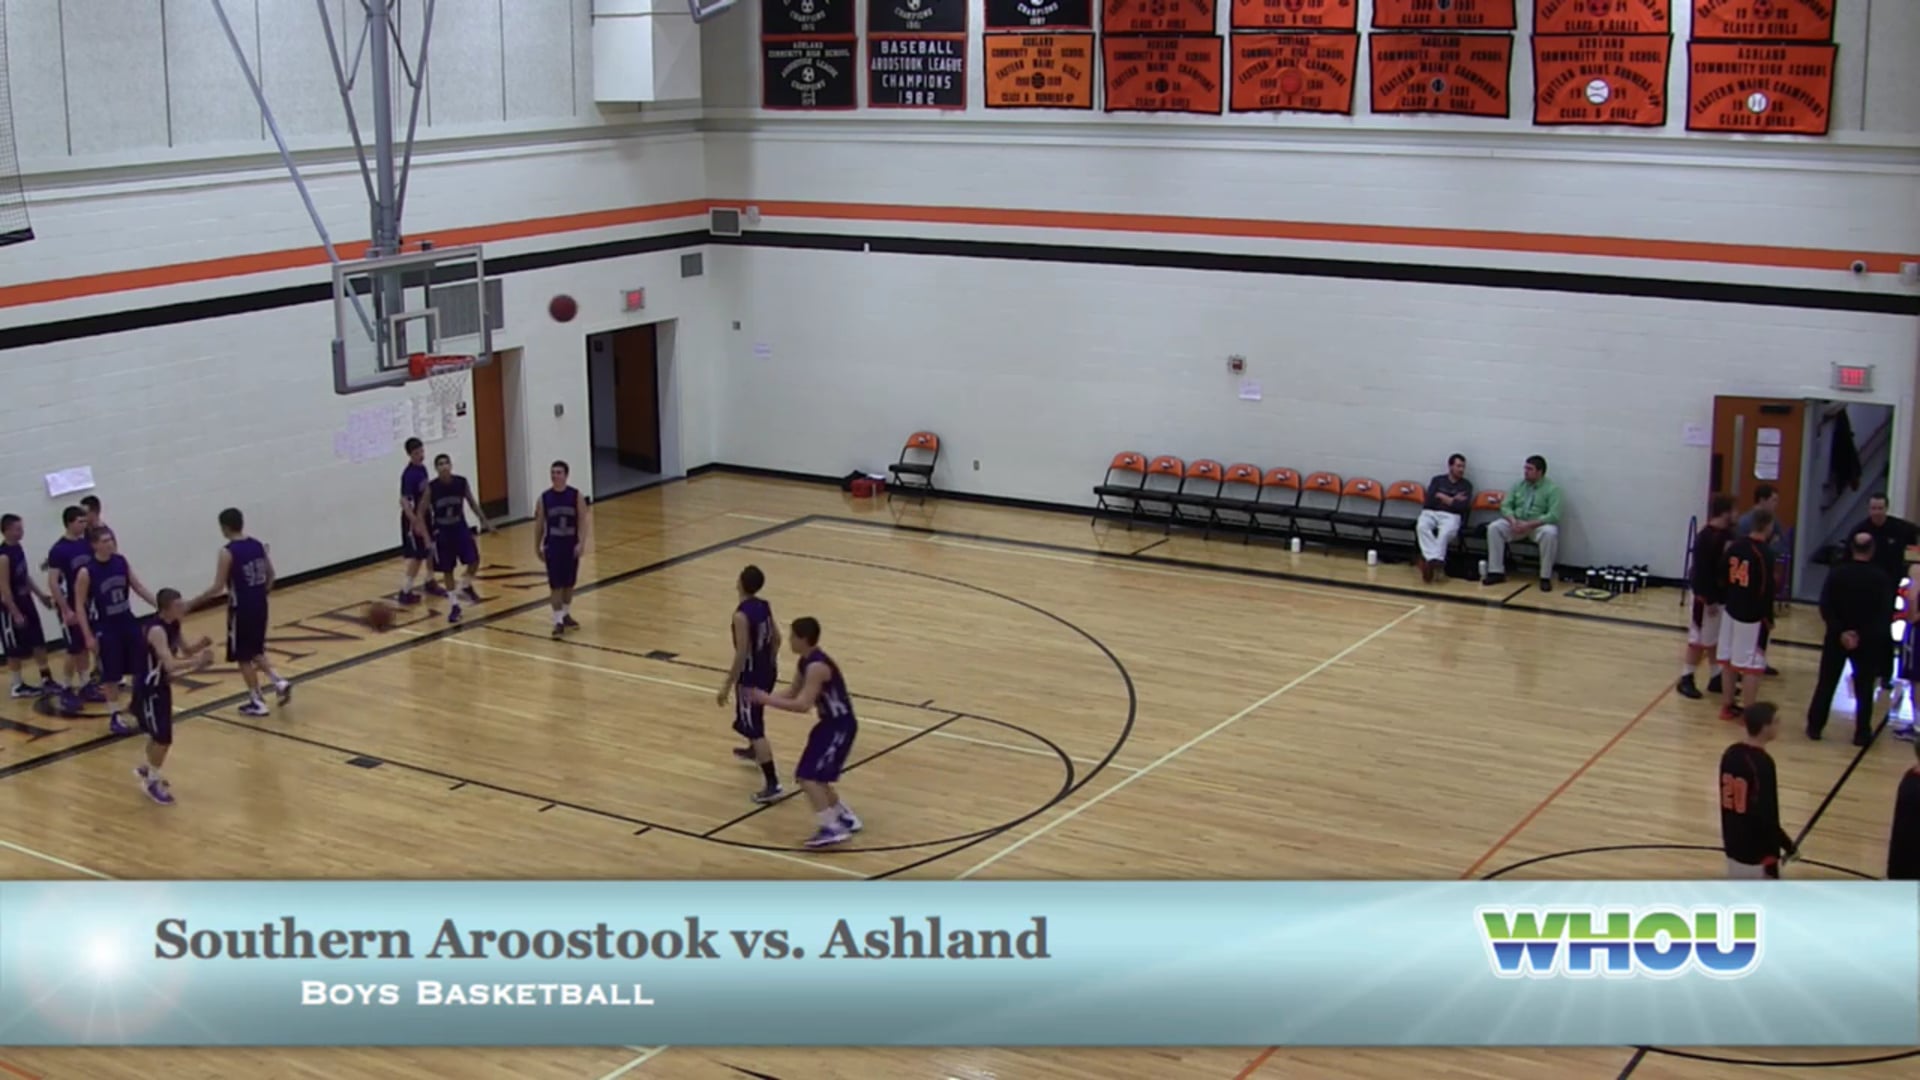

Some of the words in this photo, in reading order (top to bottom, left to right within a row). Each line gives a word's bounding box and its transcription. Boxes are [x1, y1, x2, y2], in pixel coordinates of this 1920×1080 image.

[880, 41, 954, 54] BASEBALL
[871, 57, 923, 71] AROOSTOOK
[928, 57, 963, 73] LEAGUE
[881, 74, 952, 89] CHAMPIONS
[898, 90, 936, 105] 1982
[1721, 772, 1748, 815] 20
